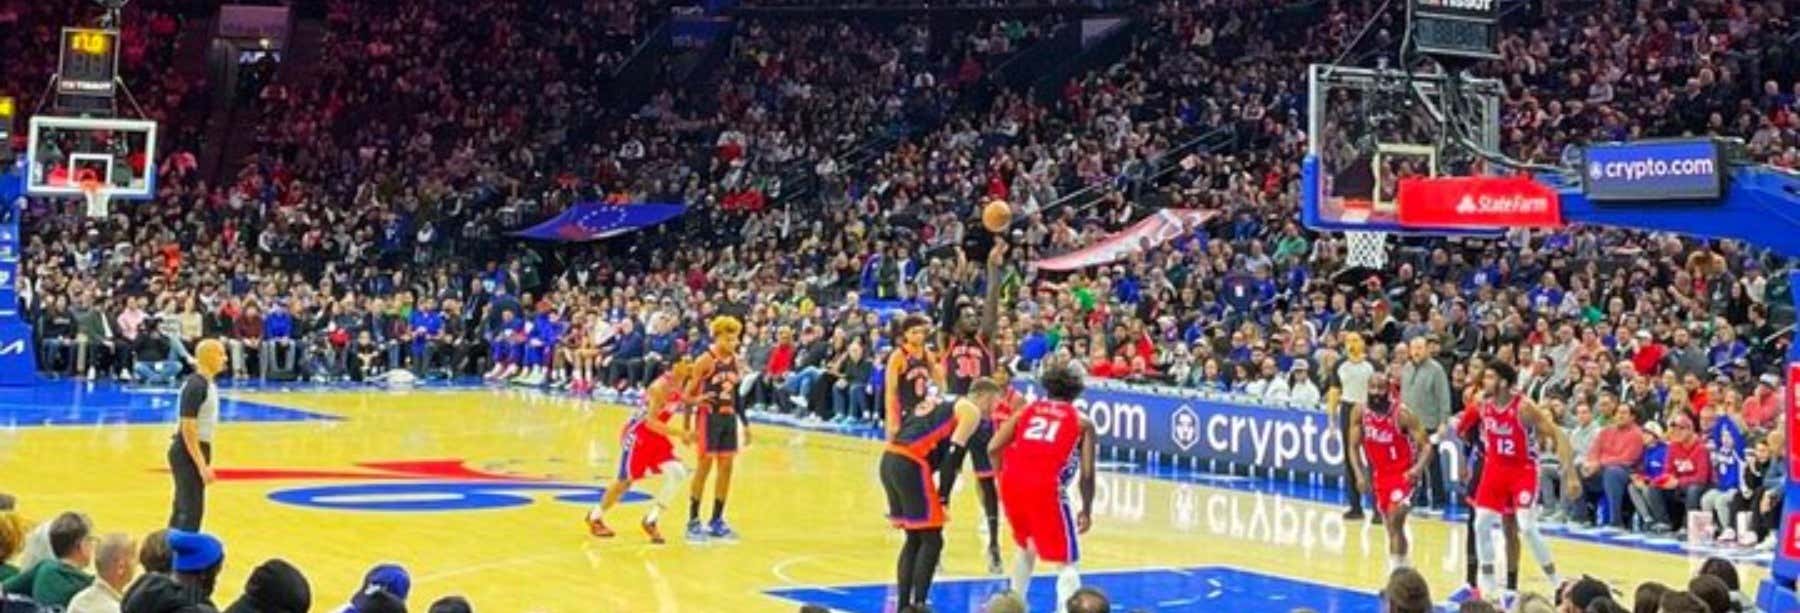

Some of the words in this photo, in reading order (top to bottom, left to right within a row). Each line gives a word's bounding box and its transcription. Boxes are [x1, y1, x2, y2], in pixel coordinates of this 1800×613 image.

[1605, 157, 1713, 181] crypto.com
[1023, 416, 1060, 442] 21
[1496, 438, 1515, 455] 12
